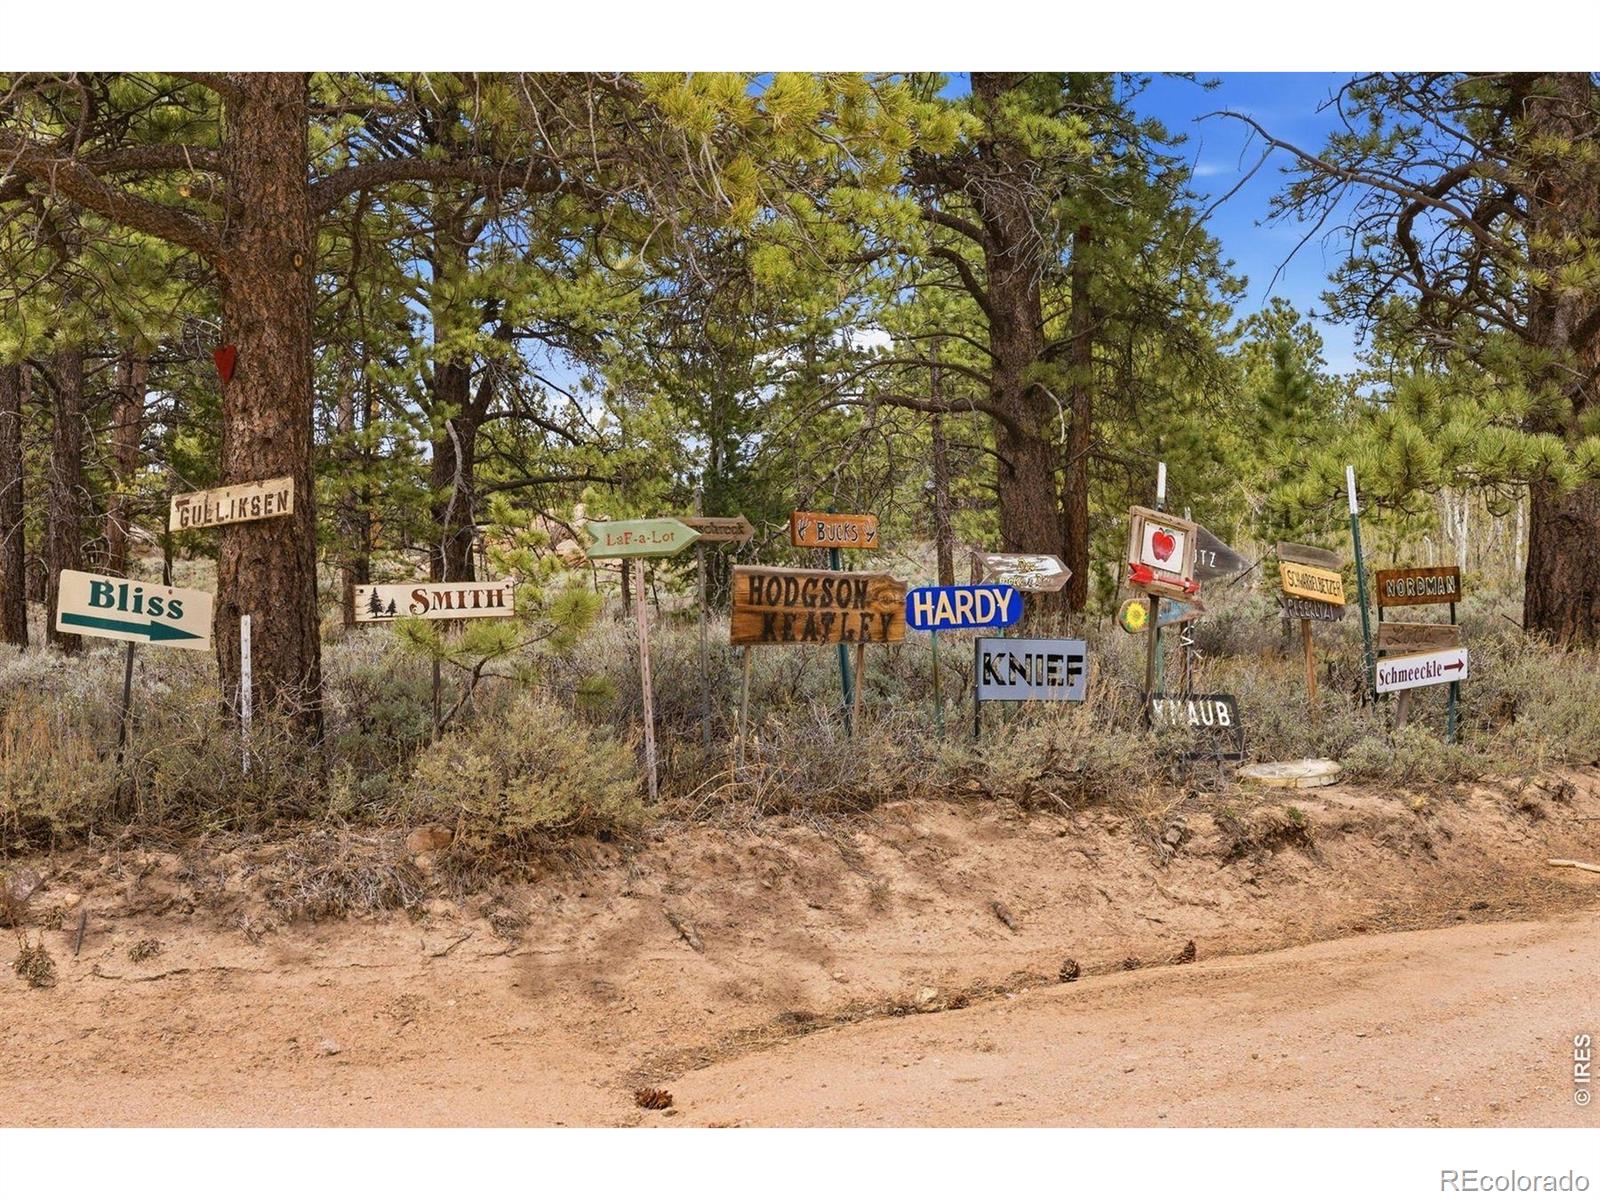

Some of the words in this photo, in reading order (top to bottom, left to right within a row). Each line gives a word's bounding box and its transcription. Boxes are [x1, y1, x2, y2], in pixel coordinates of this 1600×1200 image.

[180, 490, 289, 528] GULLIKSEN
[815, 522, 858, 542] BUCKS
[88, 580, 183, 620] Bliss
[409, 588, 506, 615] SMITH
[749, 575, 869, 609] HODGSON
[1385, 575, 1456, 597] NORDMAN
[912, 588, 1014, 626] HARDY
[761, 611, 895, 645] KEATLEY
[982, 651, 1084, 687] KNIEF
[1379, 660, 1442, 686] Schmeeckle
